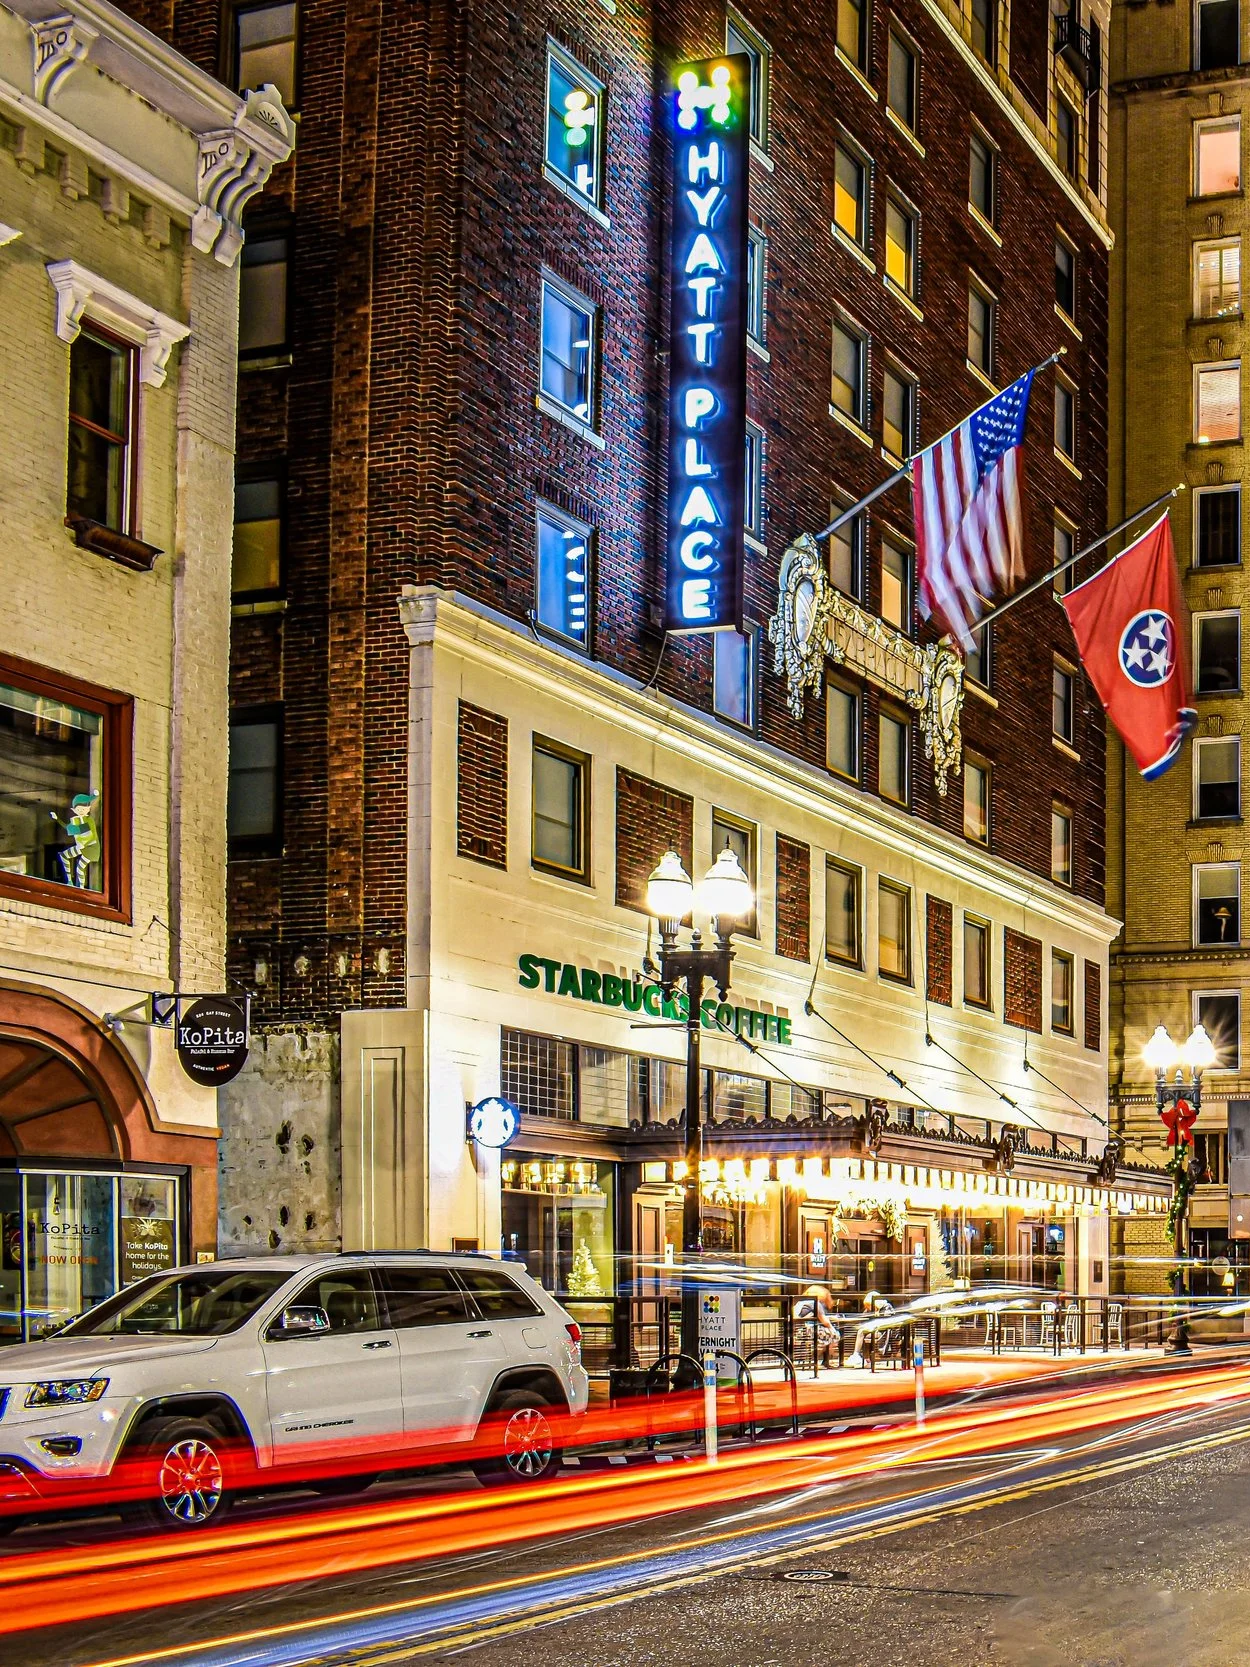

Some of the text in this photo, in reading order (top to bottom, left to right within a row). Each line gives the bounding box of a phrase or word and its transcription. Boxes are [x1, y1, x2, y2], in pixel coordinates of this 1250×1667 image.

[684, 141, 726, 364] HYATT
[680, 387, 723, 620] PLACE
[518, 953, 793, 1046] STARBUCKS COFFEE
[180, 1027, 244, 1045] KoPita
[40, 1222, 100, 1235] KoPita
[126, 1241, 168, 1250] Take KoPita
[41, 1255, 99, 1264] NOW OPEN
[125, 1251, 170, 1260] home for the
[313, 1419, 354, 1428] CHEROKEE
